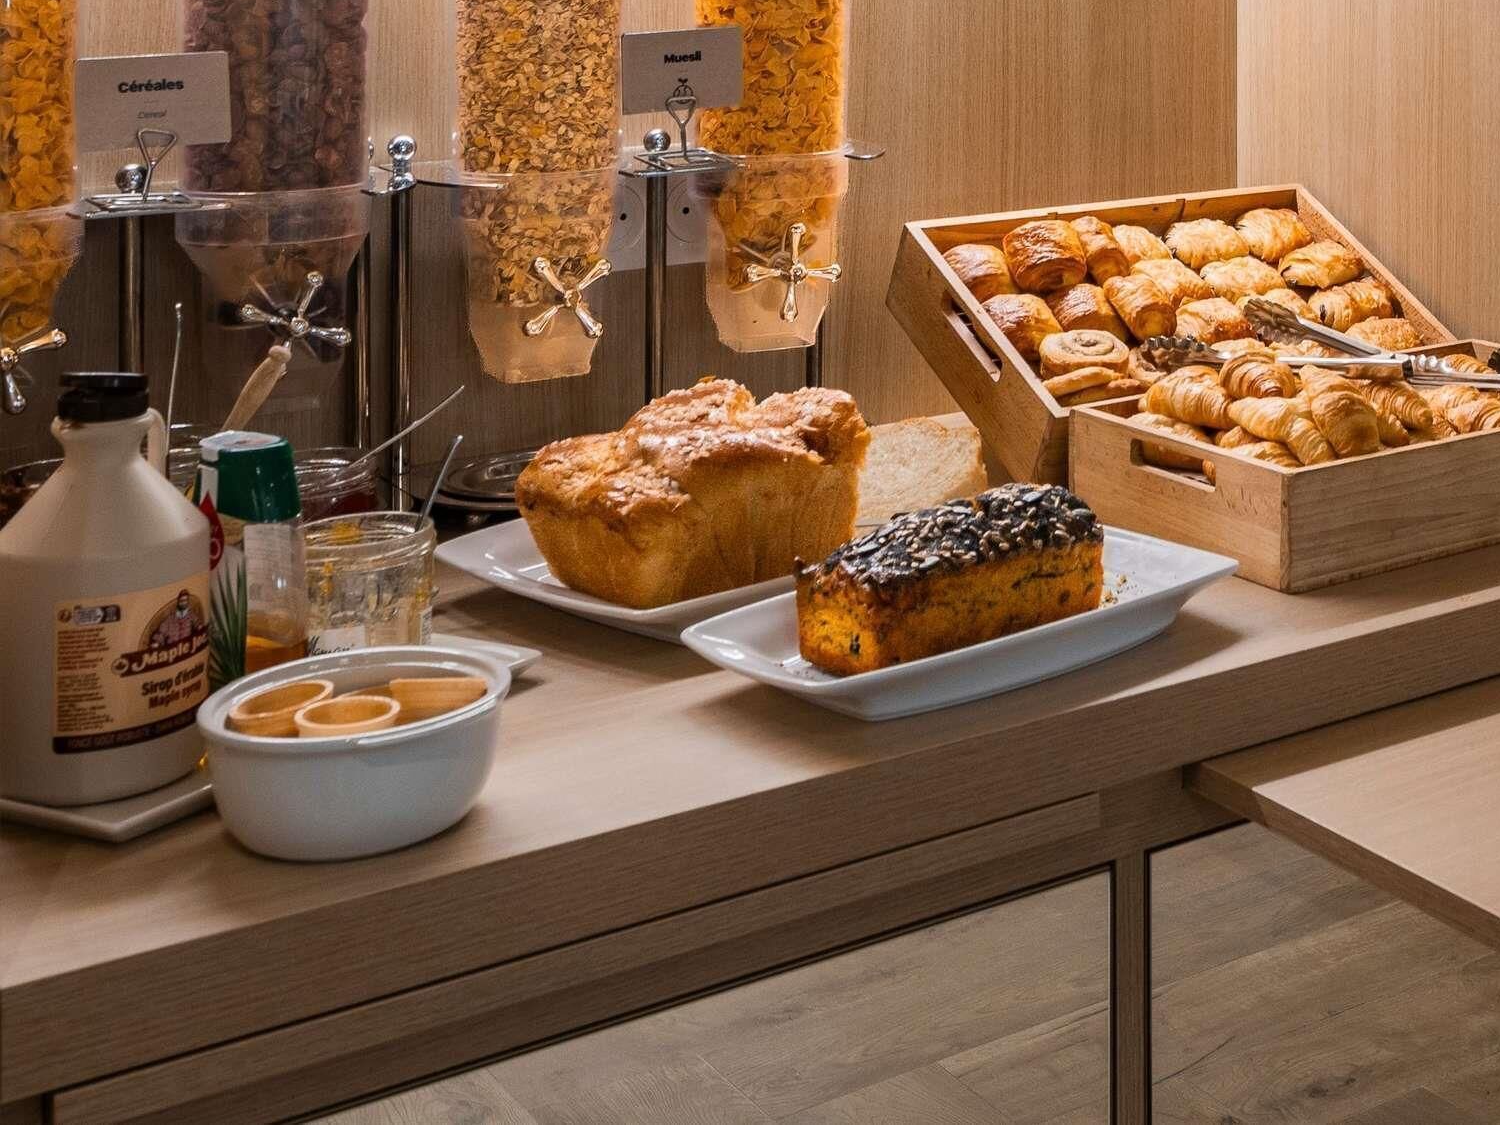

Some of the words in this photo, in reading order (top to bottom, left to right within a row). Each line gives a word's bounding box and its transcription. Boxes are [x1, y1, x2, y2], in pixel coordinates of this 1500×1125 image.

[664, 50, 701, 63] Muesli
[117, 78, 184, 93] Céréales
[131, 641, 190, 672] Maple
[141, 678, 173, 696] Sirop
[149, 689, 180, 709] Maple
